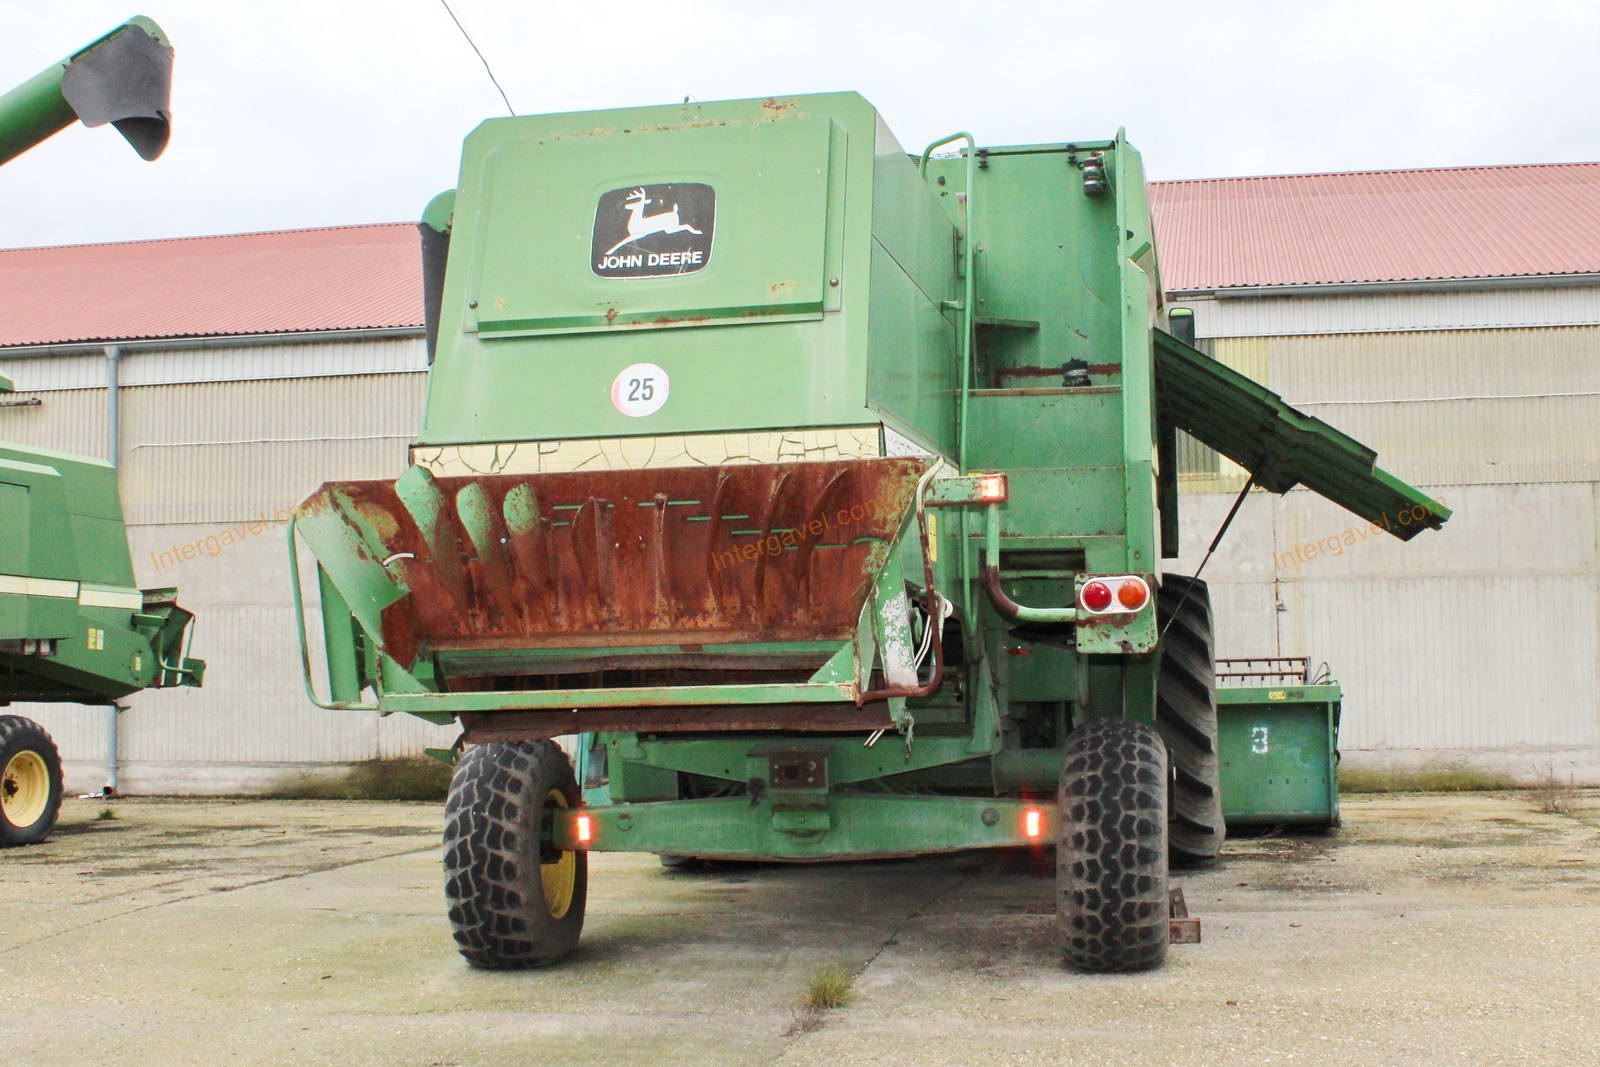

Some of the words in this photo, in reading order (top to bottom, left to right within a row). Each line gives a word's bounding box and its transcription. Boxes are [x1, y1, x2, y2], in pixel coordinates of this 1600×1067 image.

[598, 255, 642, 269] JOHN
[648, 251, 703, 266] DEERE
[627, 377, 654, 402] 25
[1251, 726, 1268, 754] 3
